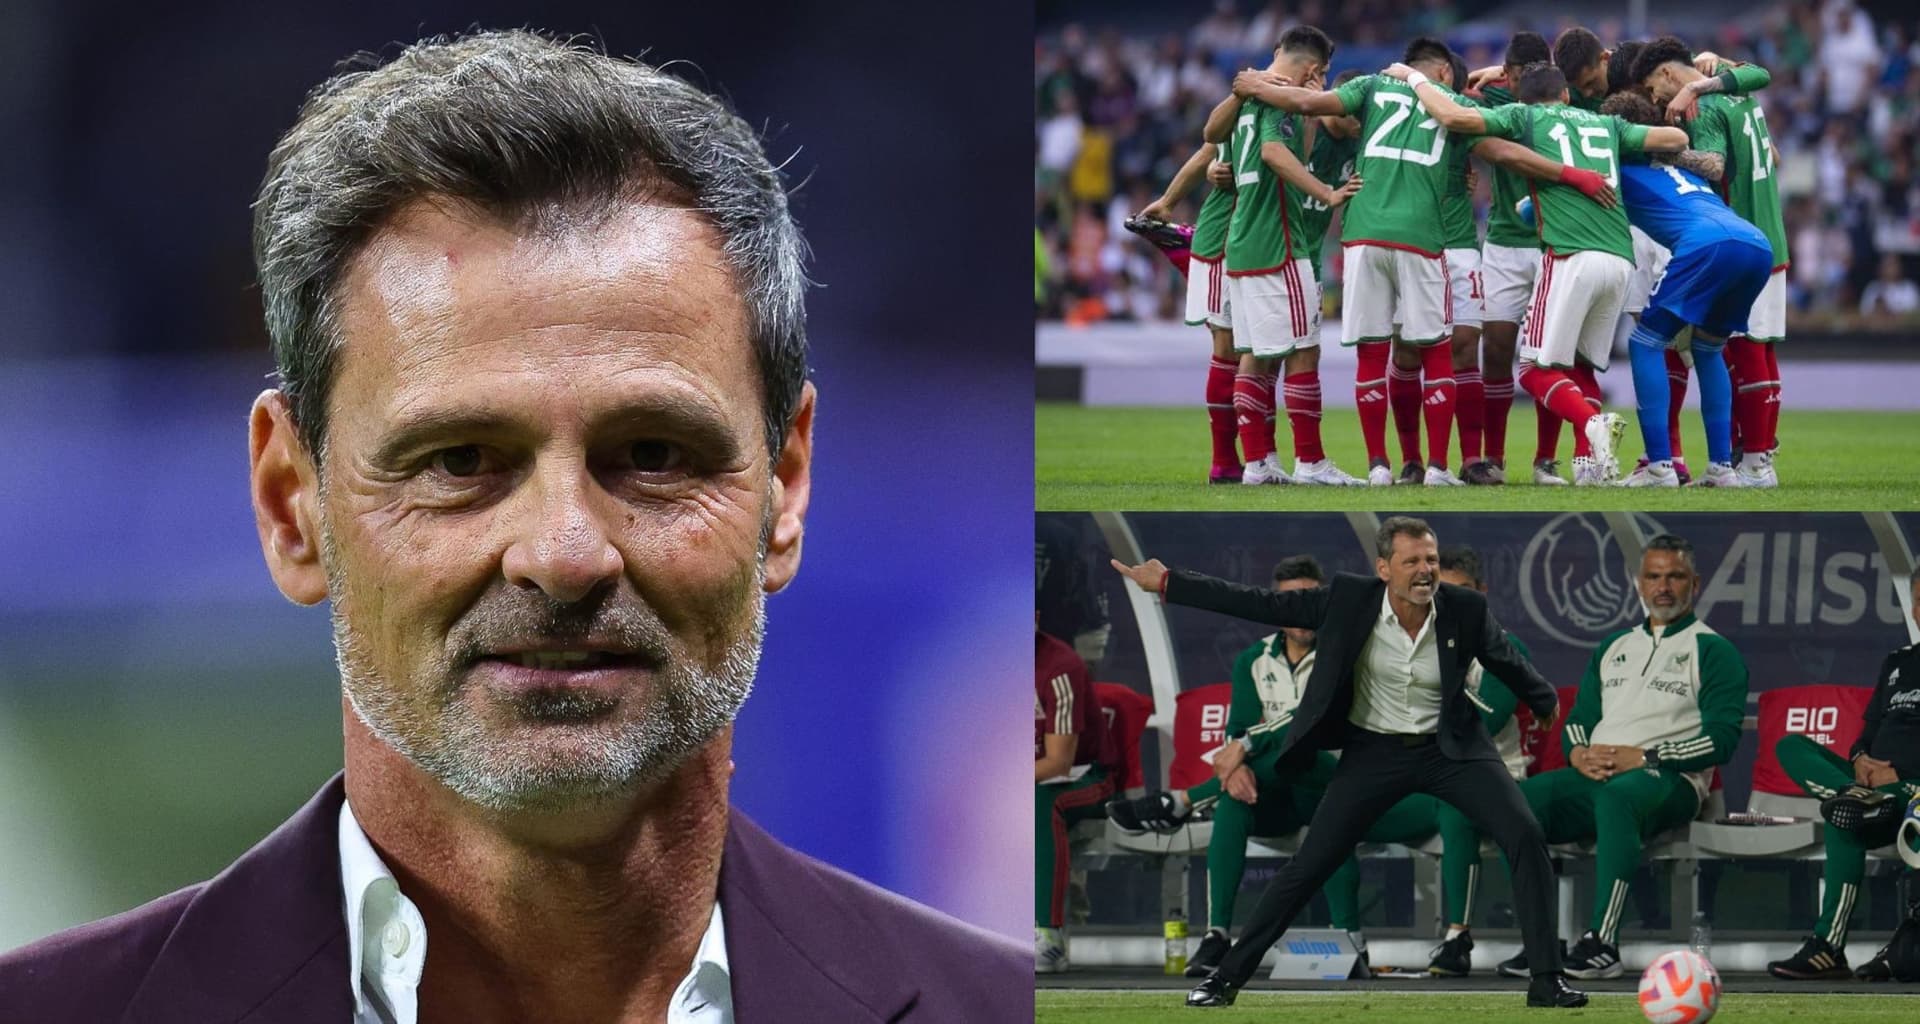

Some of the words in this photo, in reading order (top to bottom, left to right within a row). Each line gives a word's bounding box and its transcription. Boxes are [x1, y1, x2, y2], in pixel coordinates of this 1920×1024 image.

[1364, 91, 1447, 167] 23
[1548, 122, 1618, 189] 15
[1261, 700, 1287, 712] T&T
[1786, 706, 1838, 732] BIO
